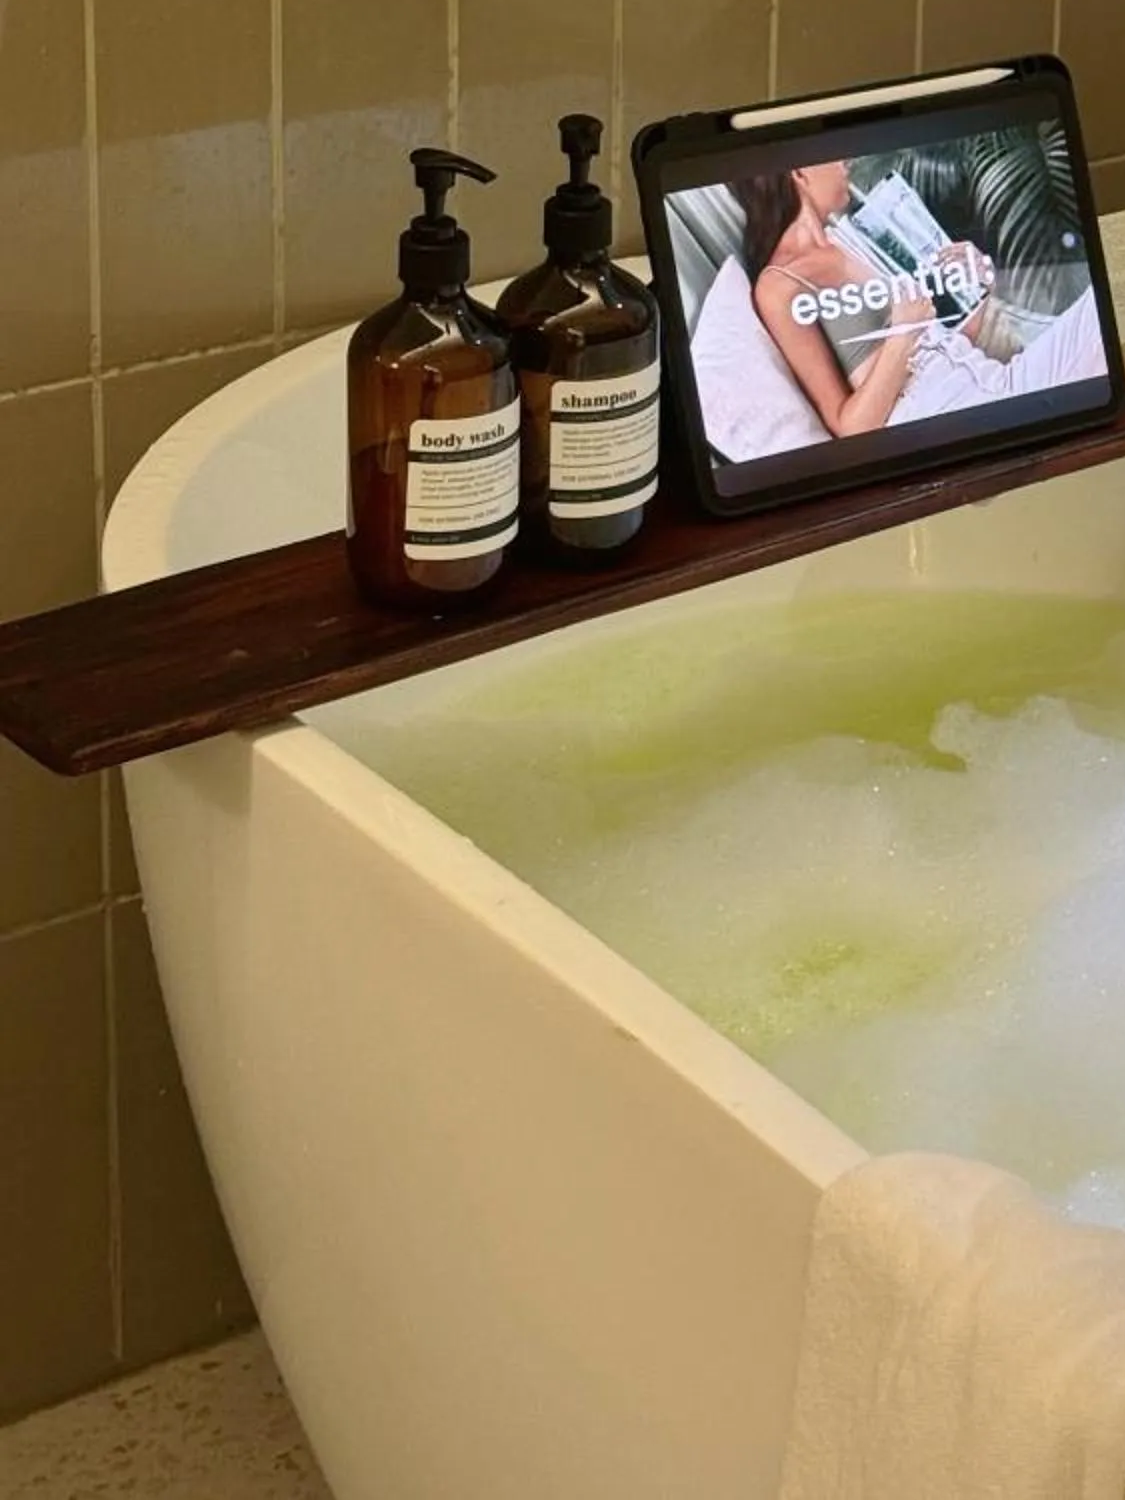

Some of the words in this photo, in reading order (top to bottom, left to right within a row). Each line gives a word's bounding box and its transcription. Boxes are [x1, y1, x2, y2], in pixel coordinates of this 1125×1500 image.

[561, 389, 637, 410] shampoo
[421, 433, 464, 450] body
[470, 424, 505, 444] wash
